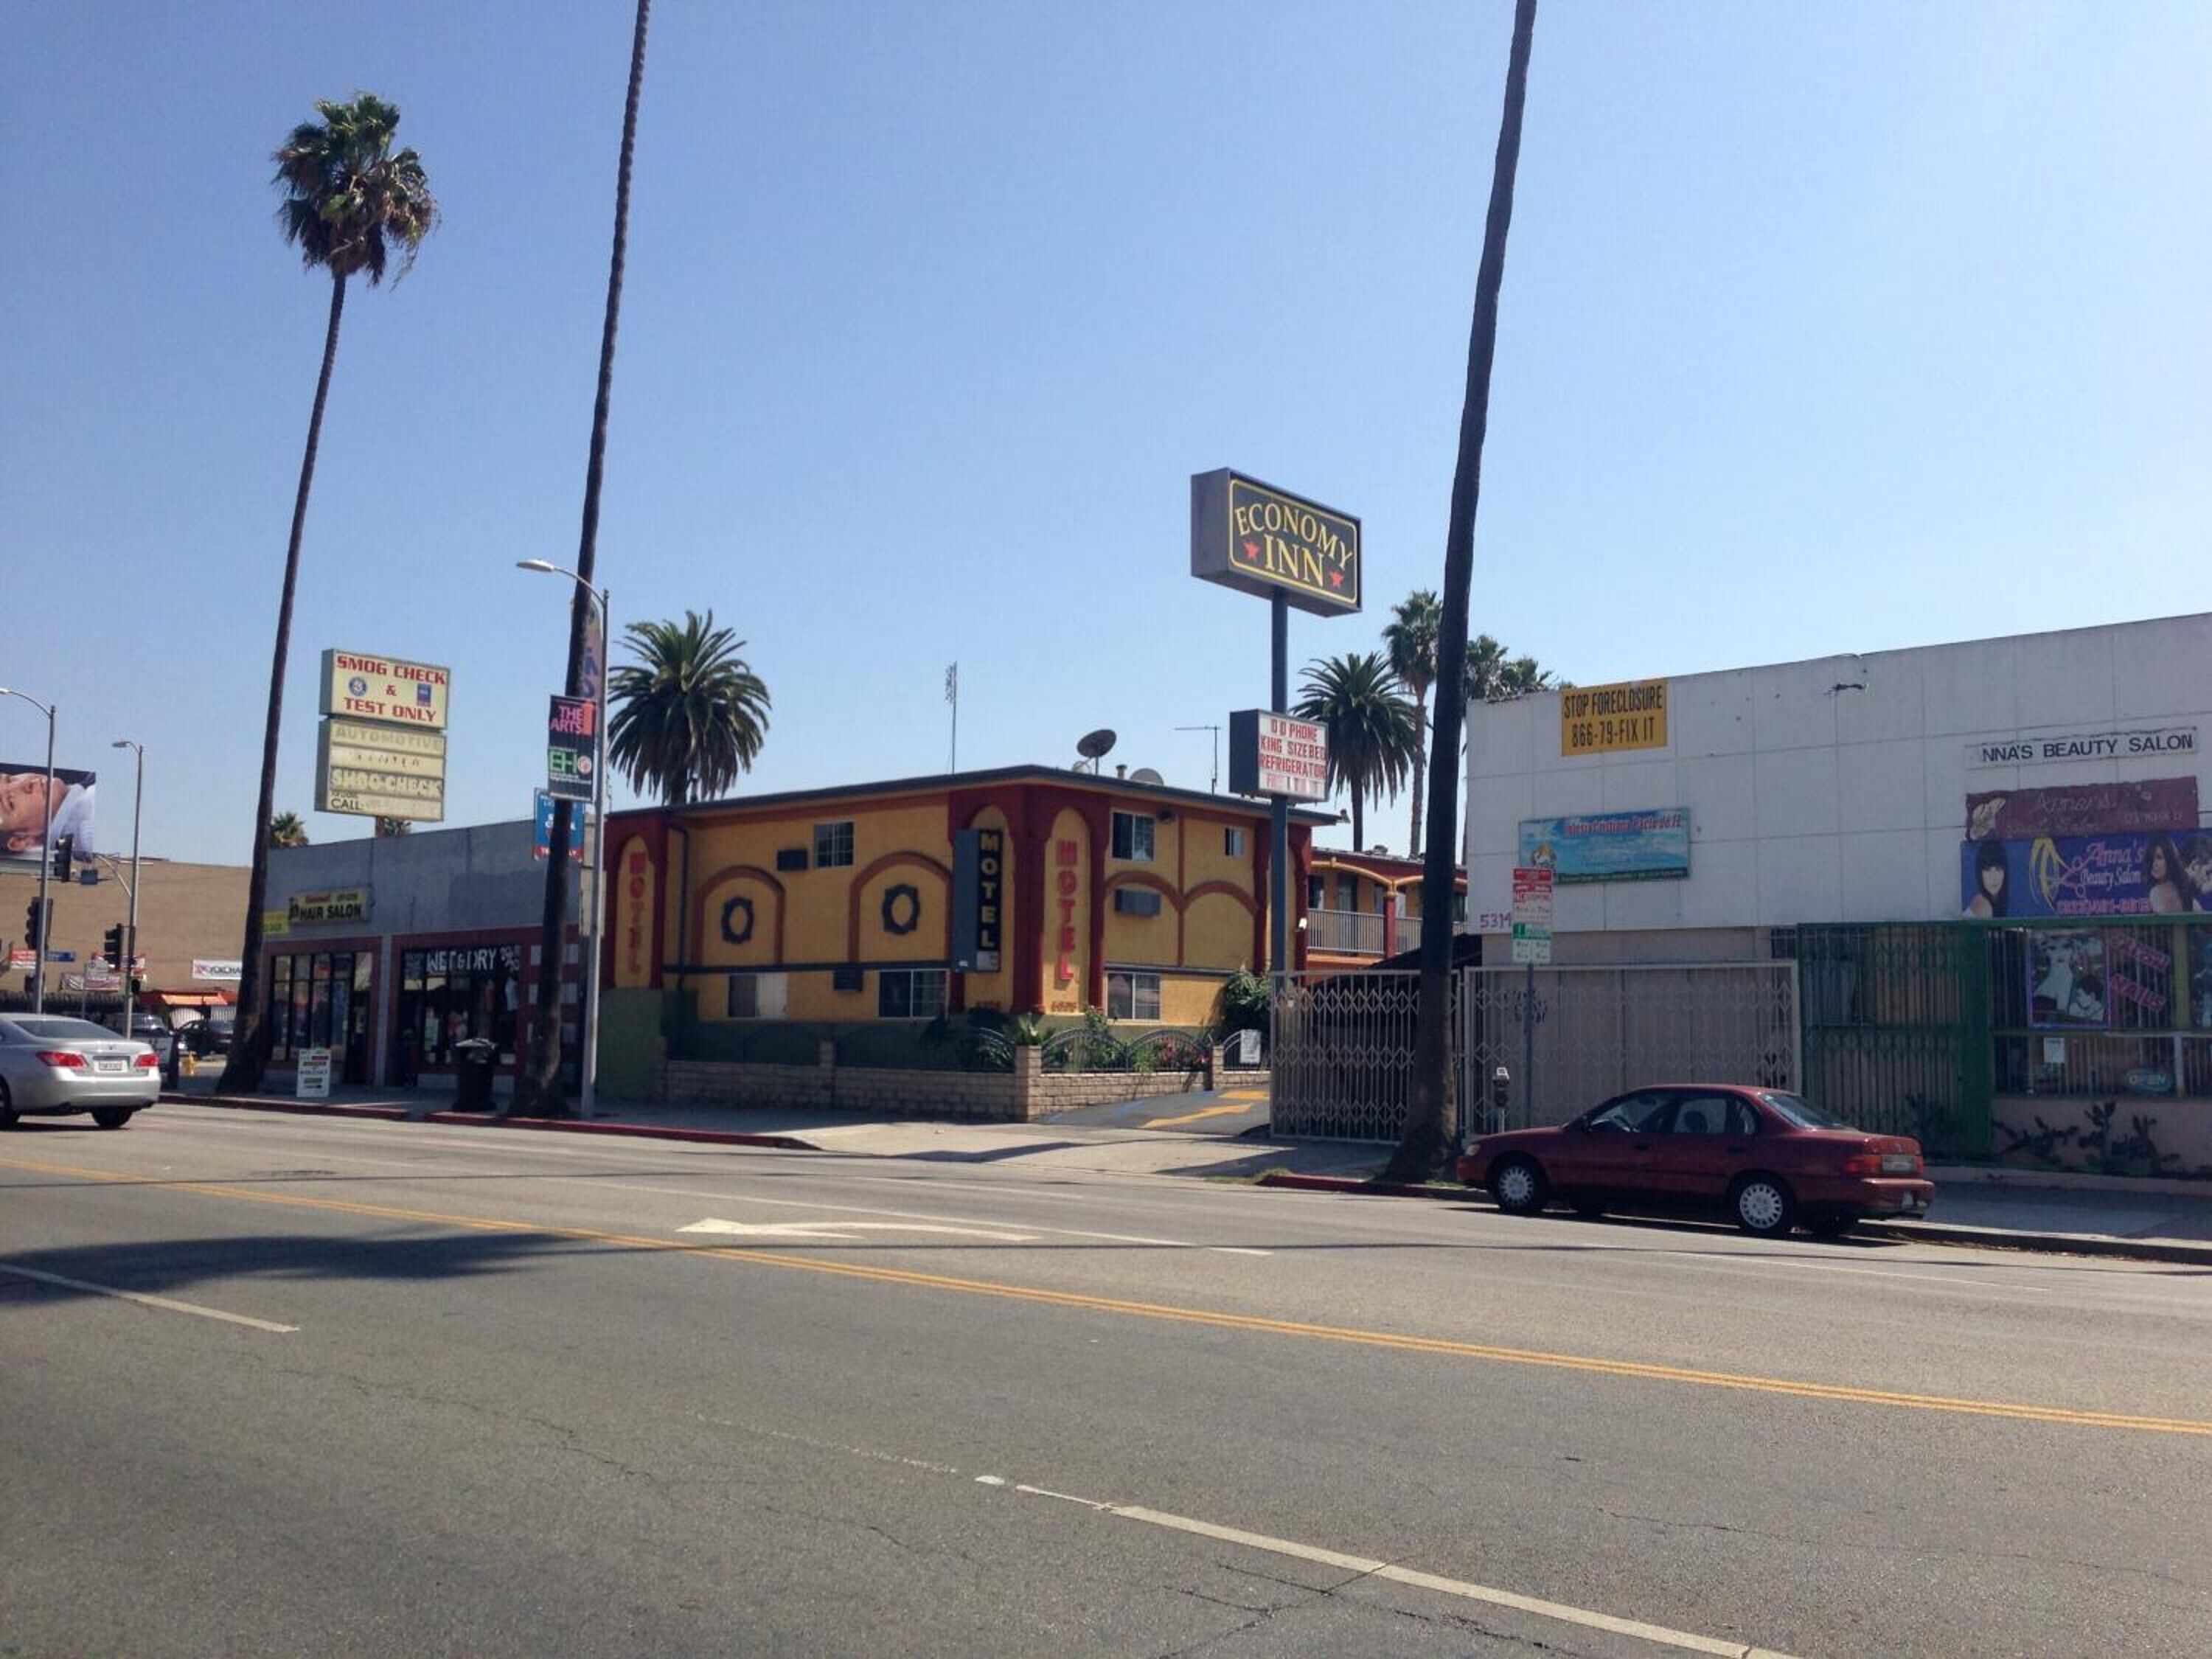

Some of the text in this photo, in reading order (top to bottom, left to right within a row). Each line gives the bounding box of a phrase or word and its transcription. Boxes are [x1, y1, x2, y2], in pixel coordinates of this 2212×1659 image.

[1234, 503, 1353, 571] ECONOMY
[1263, 533, 1324, 587] INN
[337, 655, 445, 685] SMOG CHECK
[386, 684, 397, 697] &
[1564, 686, 1663, 719] STOP FORECLOSURE
[344, 697, 437, 723] TEST ONLY
[558, 706, 584, 721] THE
[335, 726, 442, 751] AUTOMOTIVE
[550, 719, 583, 734] ARTS
[1290, 723, 1317, 742] PHONE
[1572, 716, 1655, 747] 866-79-FIX IT
[1260, 735, 1282, 752] KING
[1983, 734, 2194, 762] NNA'S BEAUTY SALON
[2088, 841, 2144, 867] Anna's
[981, 833, 1000, 949] MOTEL
[2080, 866, 2142, 891] Beauty Salon
[300, 904, 362, 920] HAIR SALON
[1057, 841, 1077, 980] MOTEL
[209, 966, 242, 975] YOKOHA
